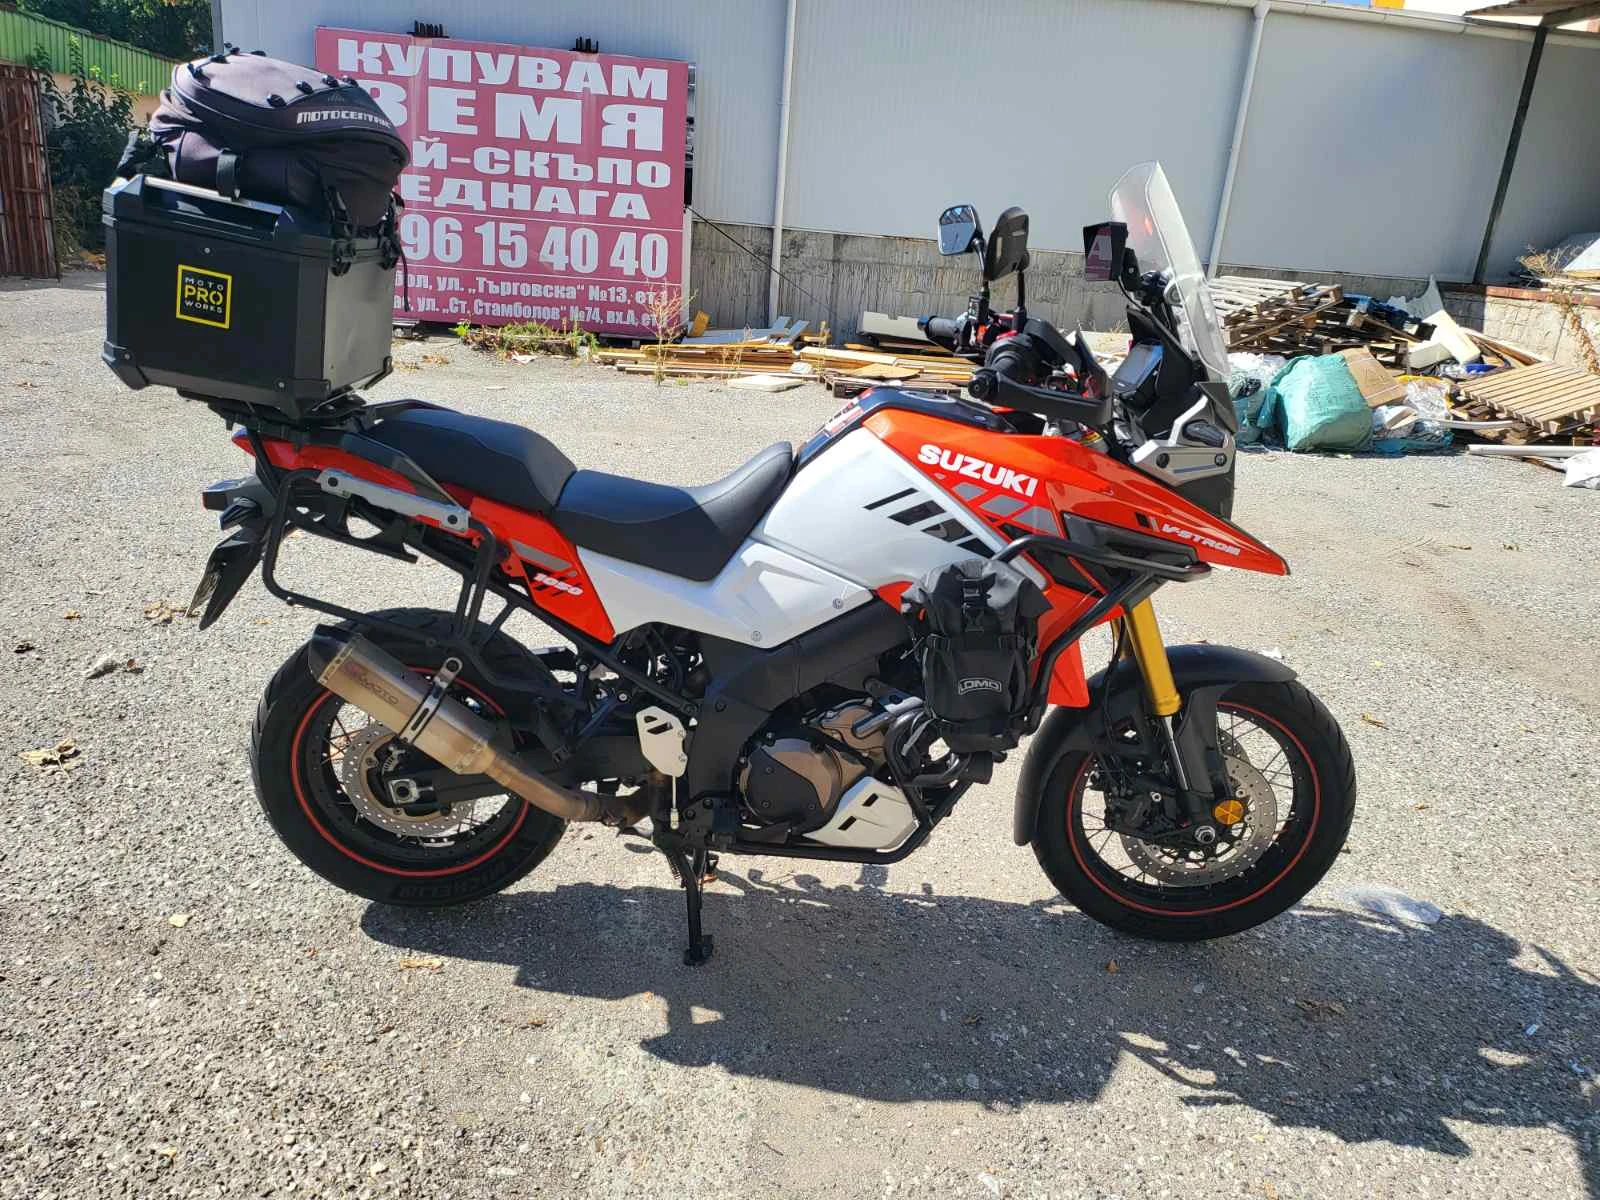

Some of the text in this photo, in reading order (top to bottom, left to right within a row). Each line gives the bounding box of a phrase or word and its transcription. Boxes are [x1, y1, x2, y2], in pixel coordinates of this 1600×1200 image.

[337, 38, 668, 101] КУПУВАМ
[412, 136, 671, 189] Й-СКЪПО
[400, 174, 652, 221] ЕДНАГА
[401, 213, 668, 278] 96 15 40 40
[184, 277, 224, 291] MOTO
[184, 284, 224, 306] PRO
[184, 299, 223, 314] WORKS
[917, 443, 1039, 498] SUZUKI
[1161, 523, 1241, 556] V-STROM
